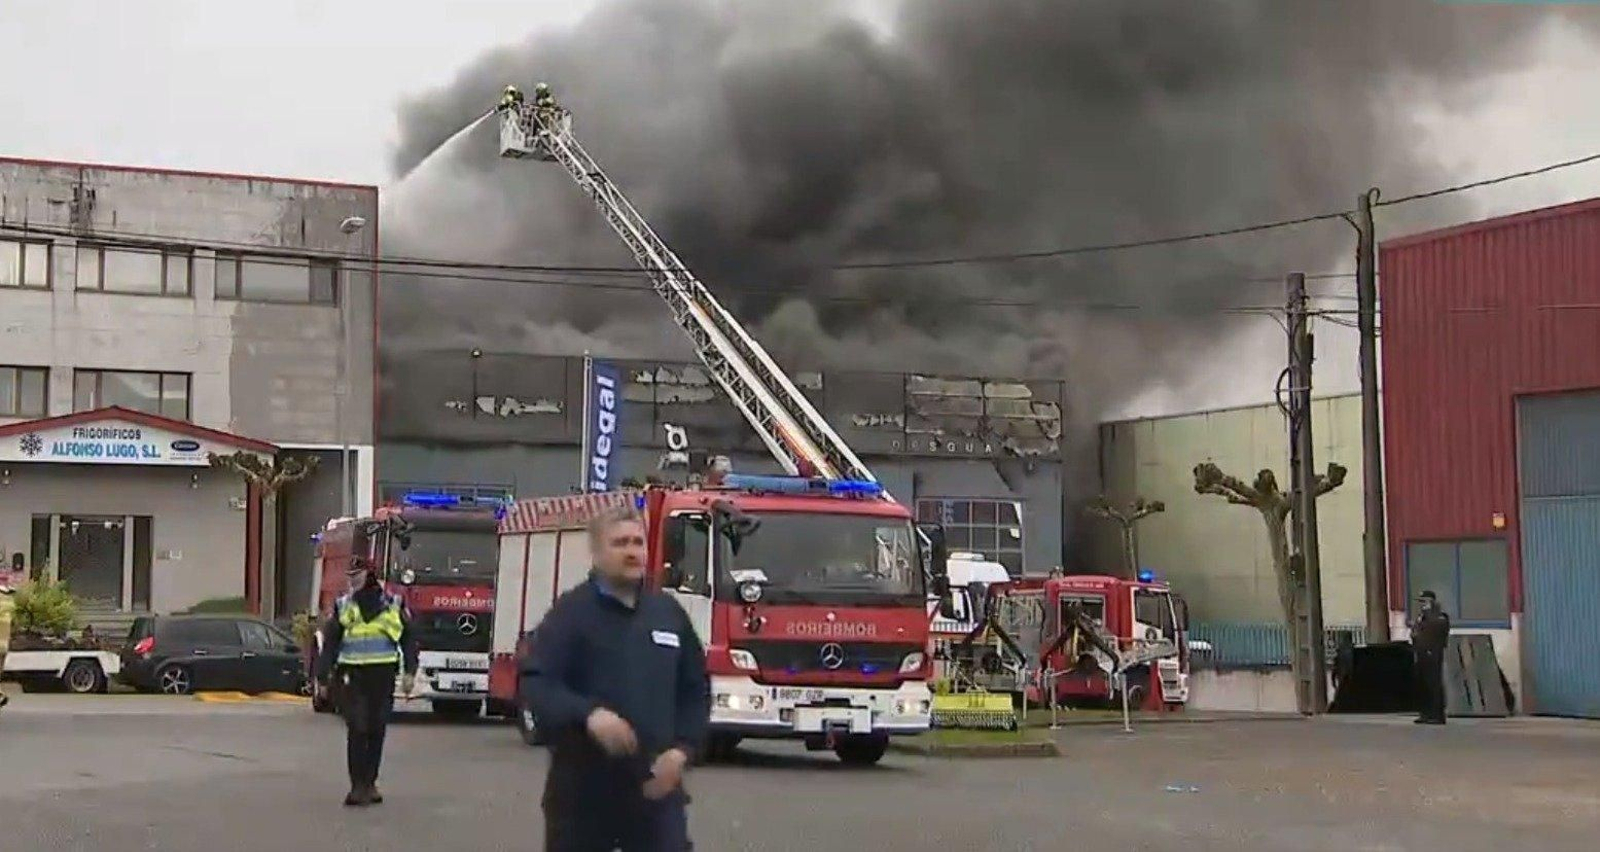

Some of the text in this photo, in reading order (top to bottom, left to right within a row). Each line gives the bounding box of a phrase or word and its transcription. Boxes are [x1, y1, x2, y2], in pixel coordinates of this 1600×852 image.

[51, 441, 105, 457] ALFONSO
[106, 443, 140, 459] LUGO,
[142, 444, 161, 458] S.L.
